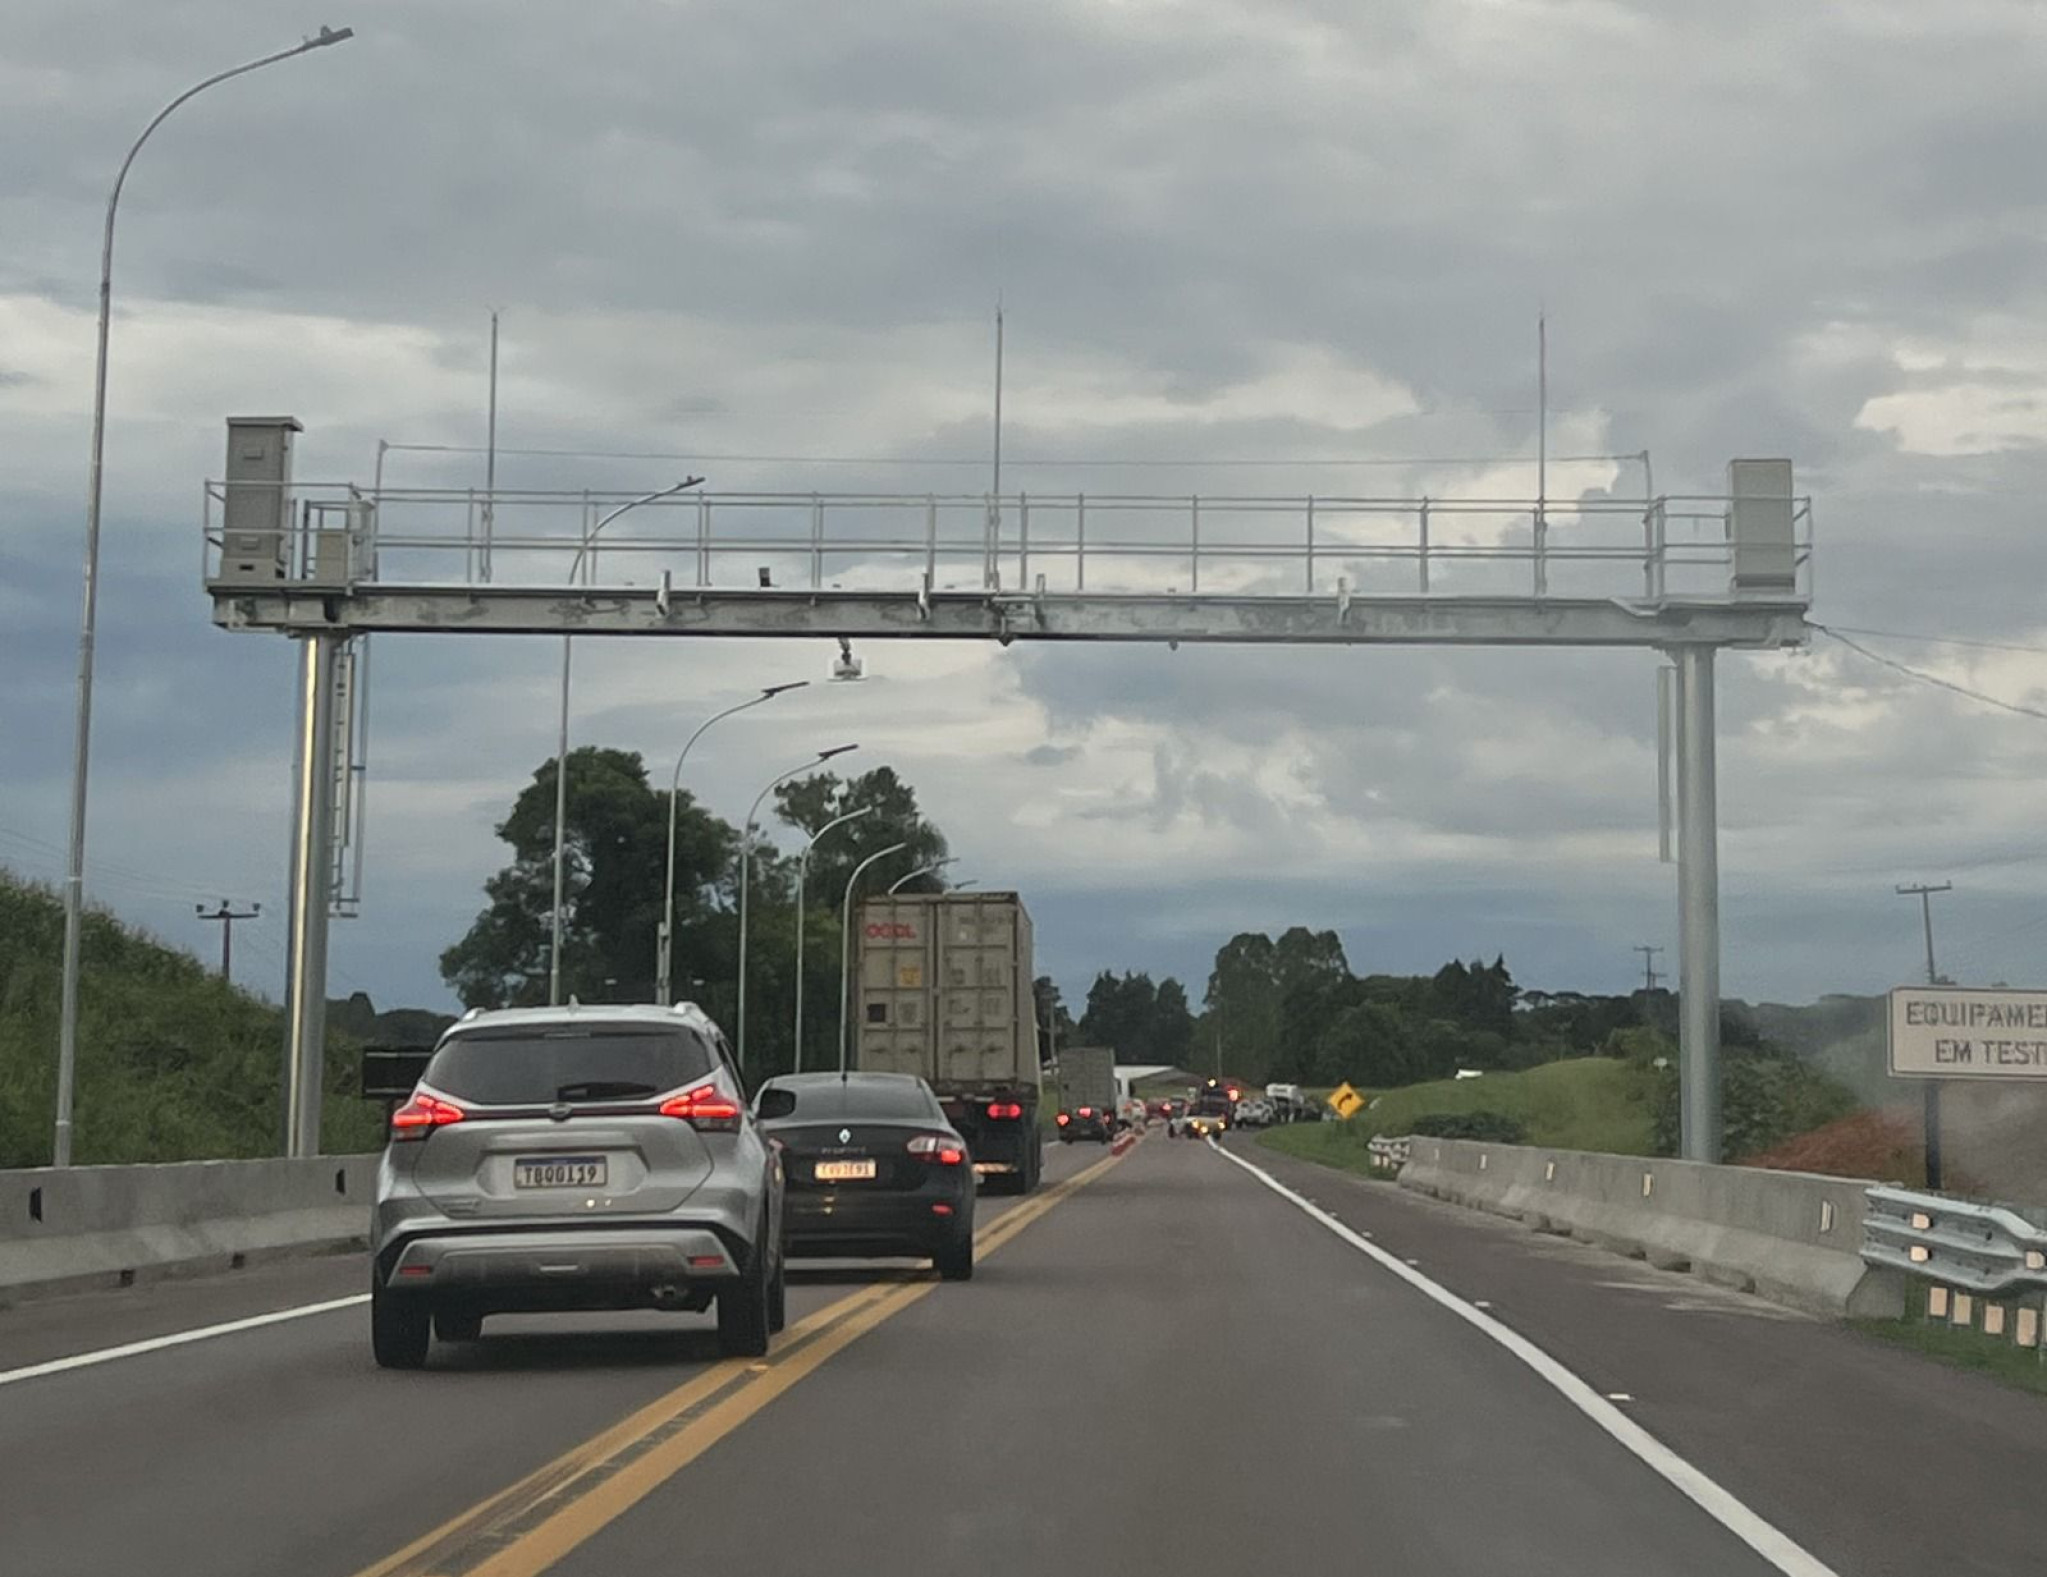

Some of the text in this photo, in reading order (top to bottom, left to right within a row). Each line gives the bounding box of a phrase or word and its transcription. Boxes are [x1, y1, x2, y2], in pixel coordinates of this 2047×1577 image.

[1906, 1001, 2047, 1028] EQUIPAME
[1935, 1040, 2047, 1065] EM TEST
